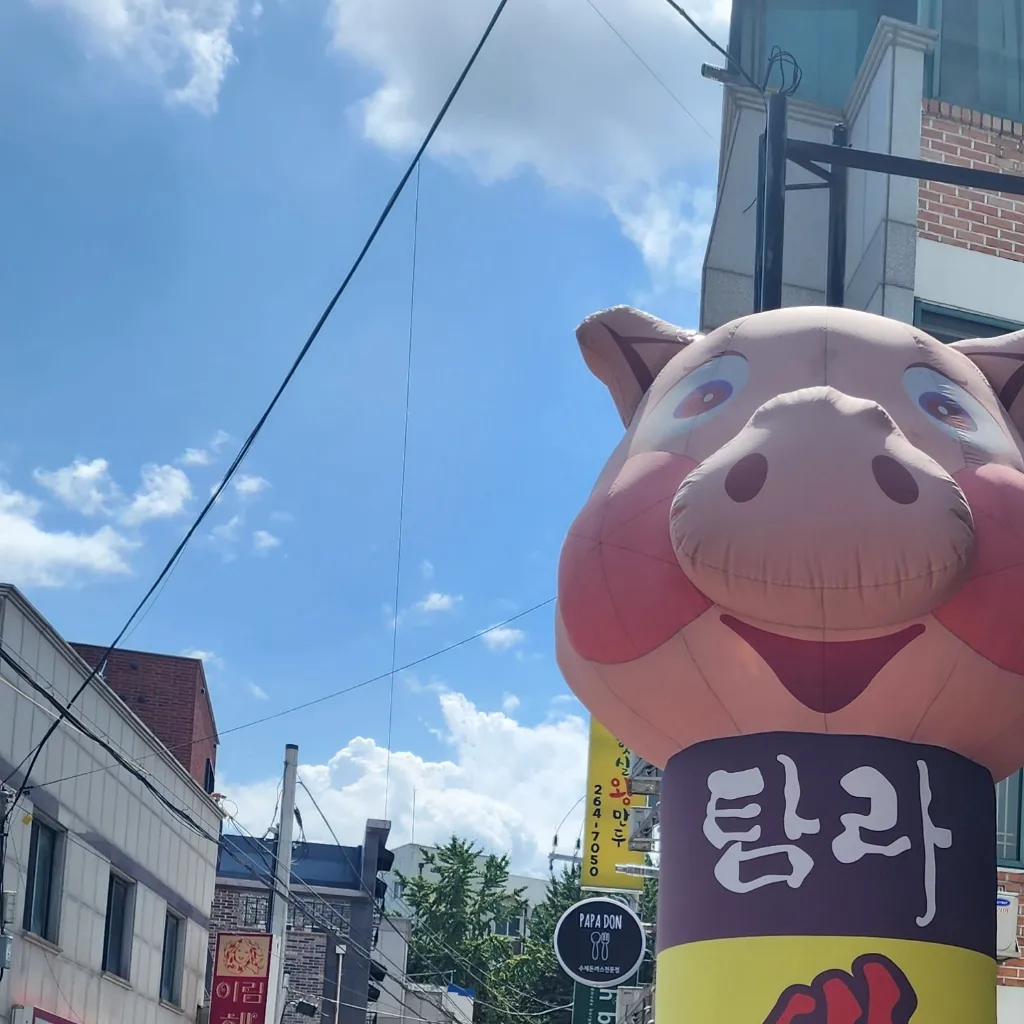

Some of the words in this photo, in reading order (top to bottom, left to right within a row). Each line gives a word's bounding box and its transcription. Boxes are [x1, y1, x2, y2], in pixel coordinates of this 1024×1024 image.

[589, 785, 602, 877] 264-7050
[703, 754, 952, 927] 탐라
[579, 912, 601, 929] PAPA
[603, 913, 623, 930] DON
[216, 981, 264, 1004] 이림
